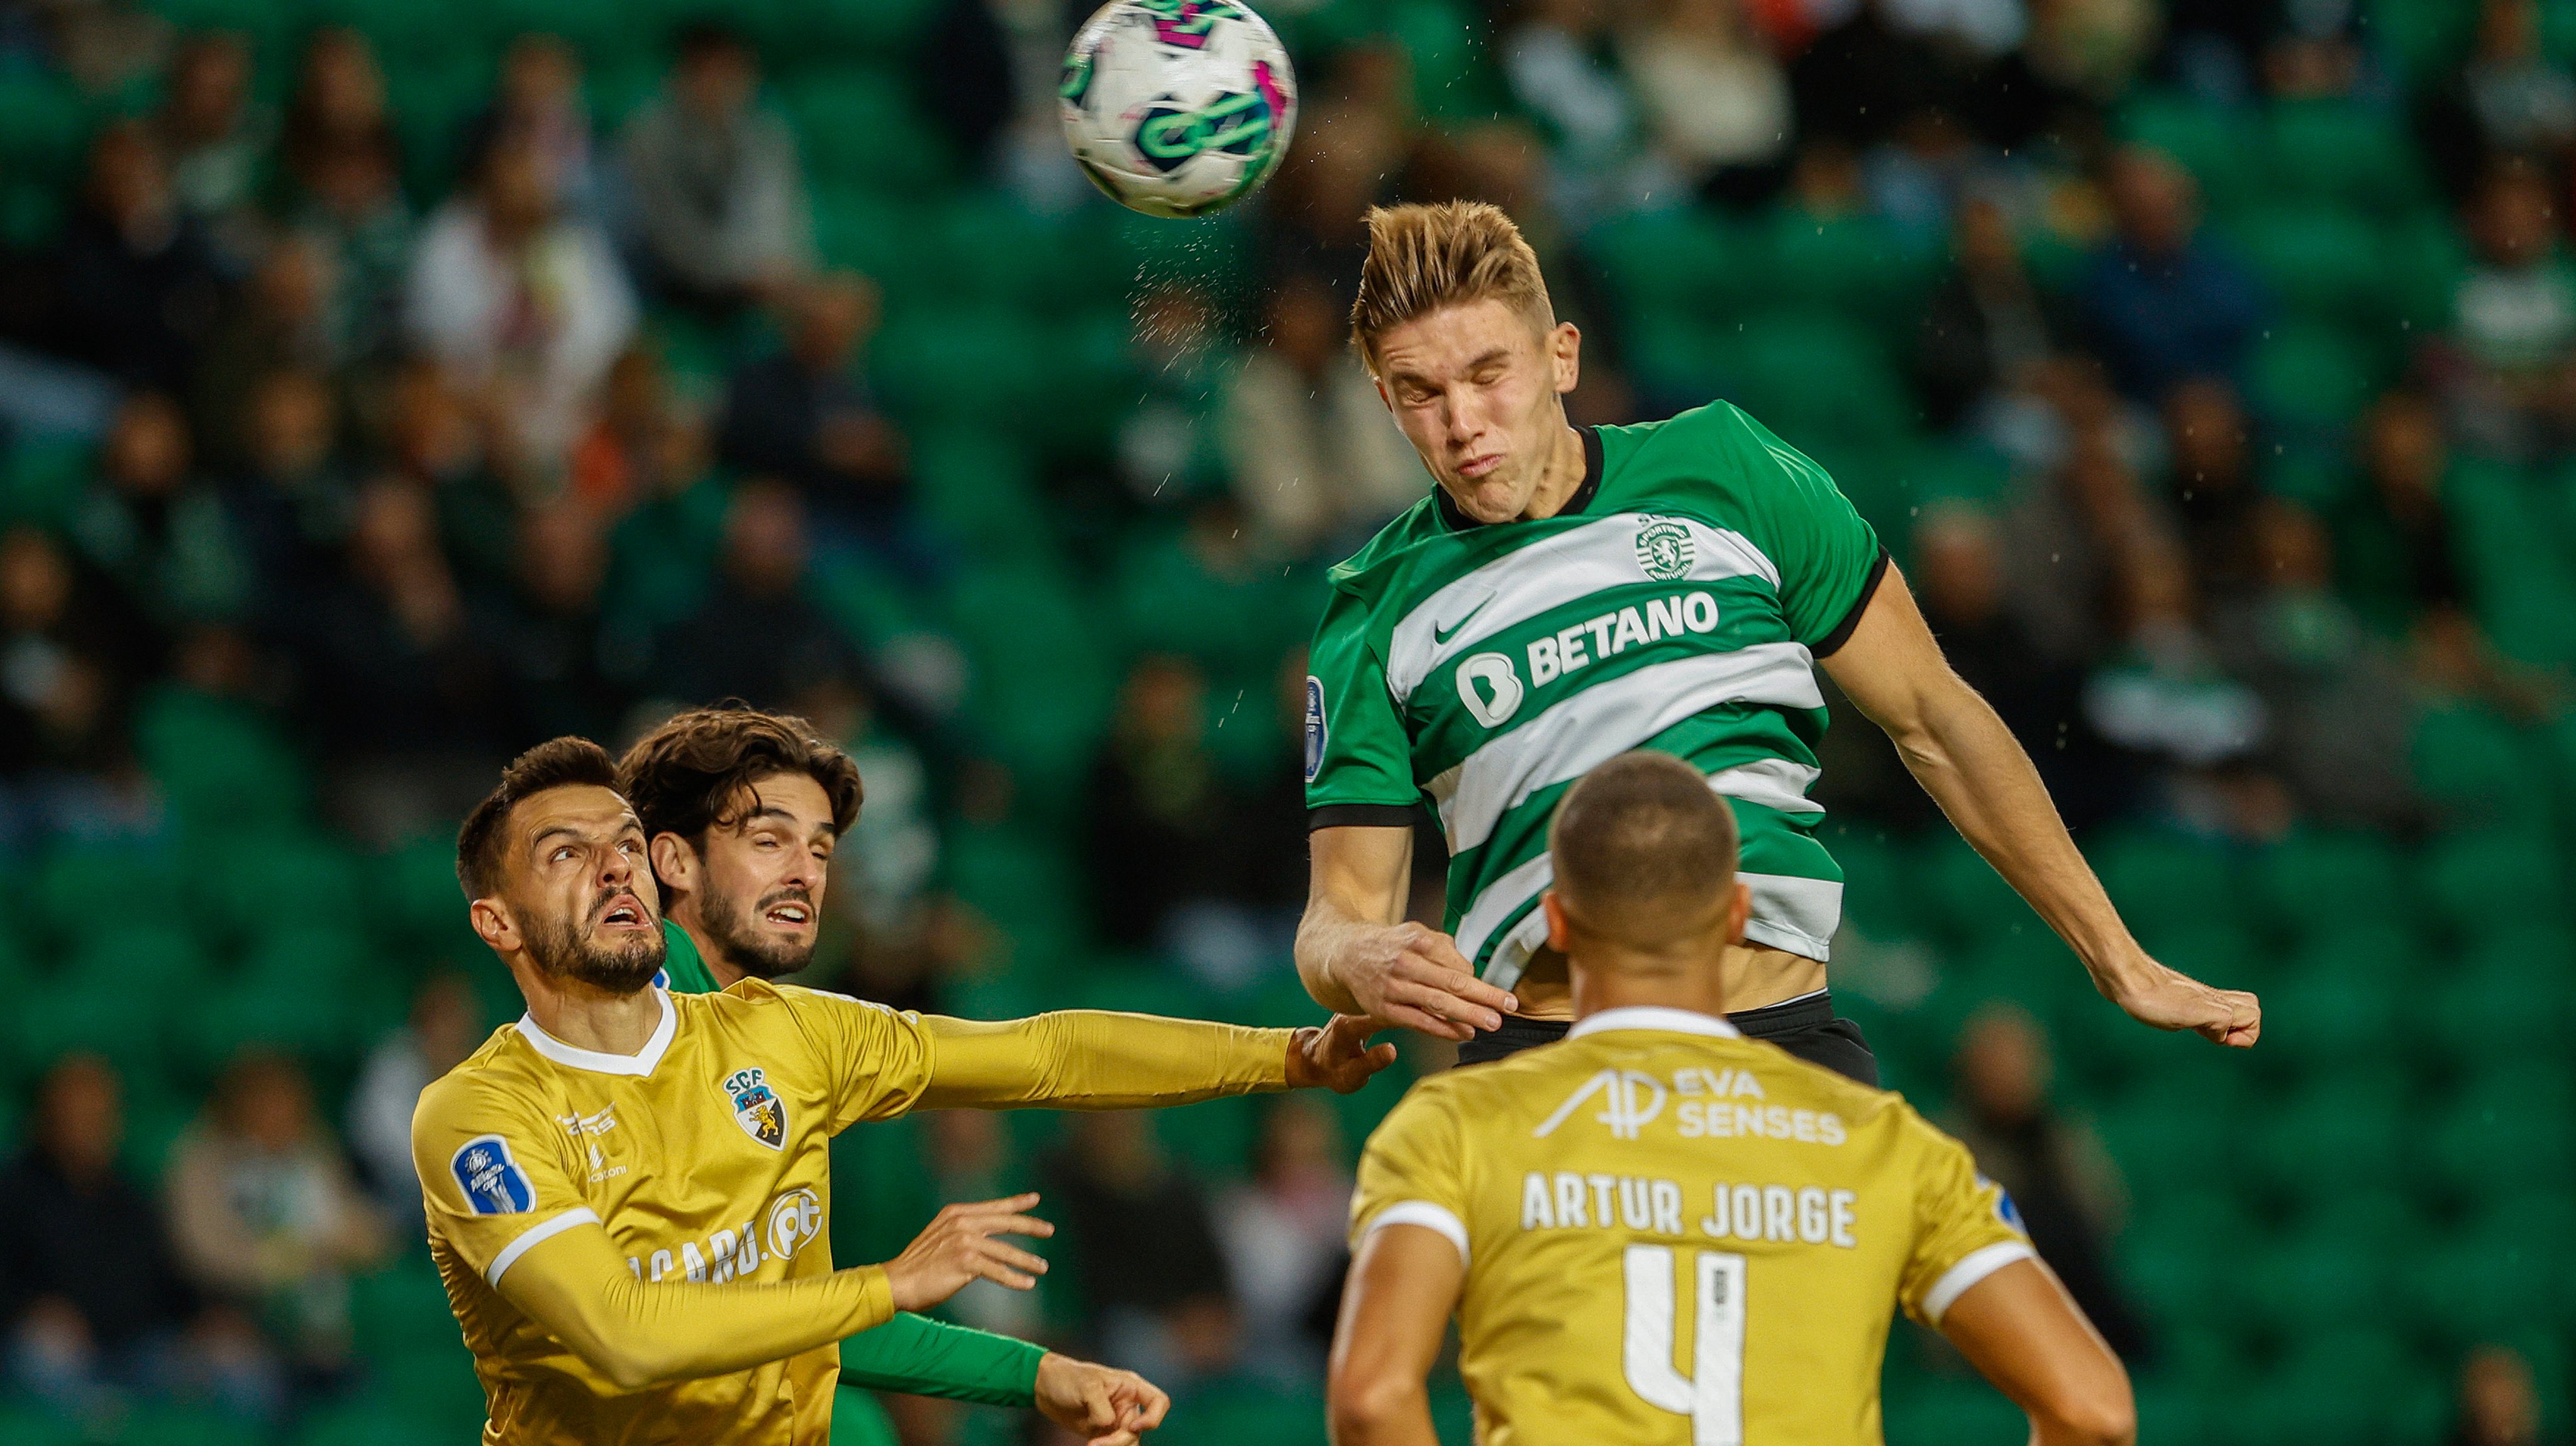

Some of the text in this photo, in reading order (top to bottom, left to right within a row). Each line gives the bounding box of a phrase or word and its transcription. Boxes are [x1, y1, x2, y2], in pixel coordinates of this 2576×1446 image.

[1638, 525, 1687, 546] SPORTING
[1526, 591, 1719, 689] BETANO
[725, 1069, 762, 1094] SCF
[1673, 1067, 1765, 1099] EVA
[1676, 1102, 1847, 1146] SENSES
[1520, 1171, 1857, 1248] ARTUR JORGE
[1622, 1243, 1747, 1446] 4
